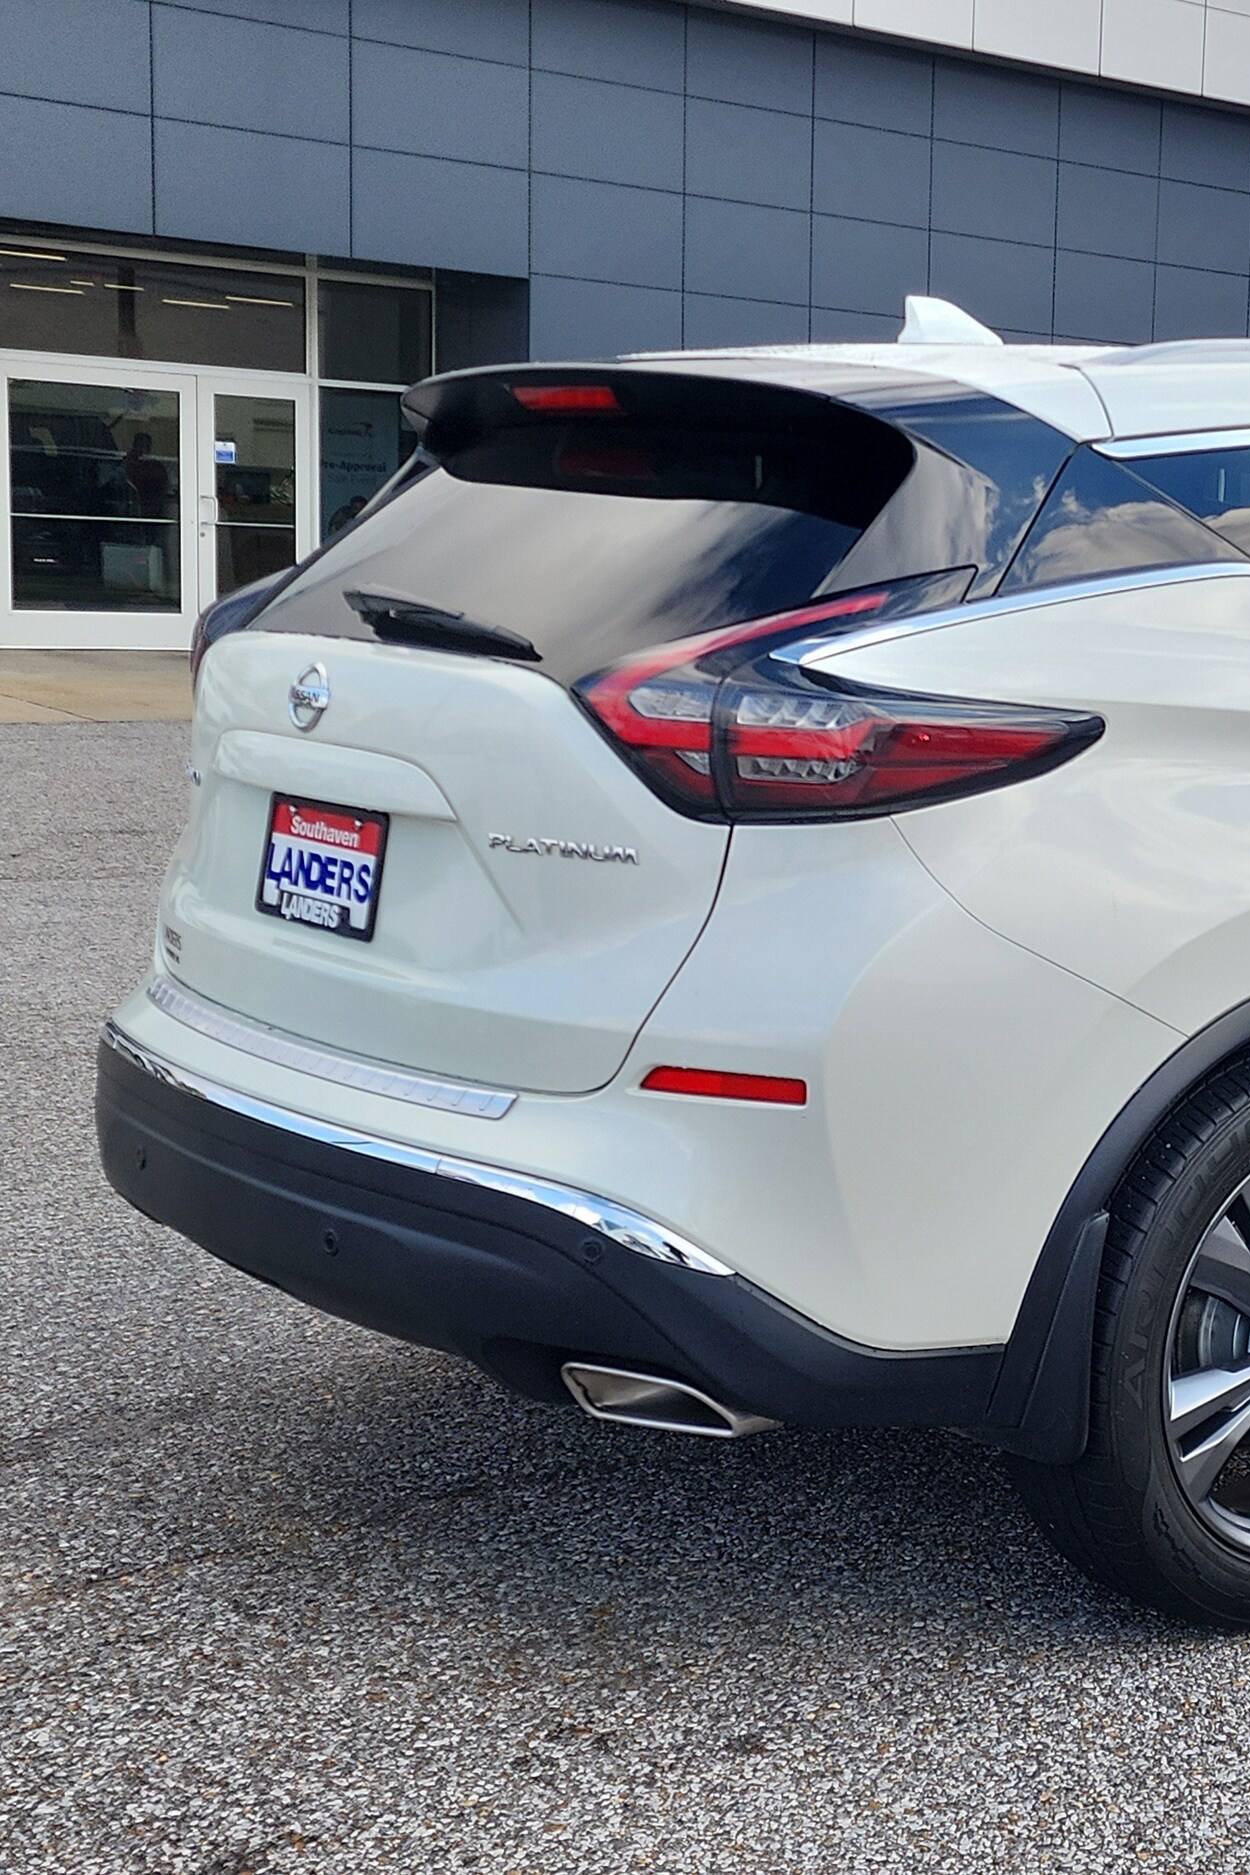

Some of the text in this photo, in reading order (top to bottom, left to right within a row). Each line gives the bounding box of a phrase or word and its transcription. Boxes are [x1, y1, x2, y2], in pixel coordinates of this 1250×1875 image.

[290, 815, 360, 848] Southaven
[488, 831, 640, 866] PLATINUM
[265, 842, 372, 904] LANDERS
[280, 893, 342, 929] LANDERS
